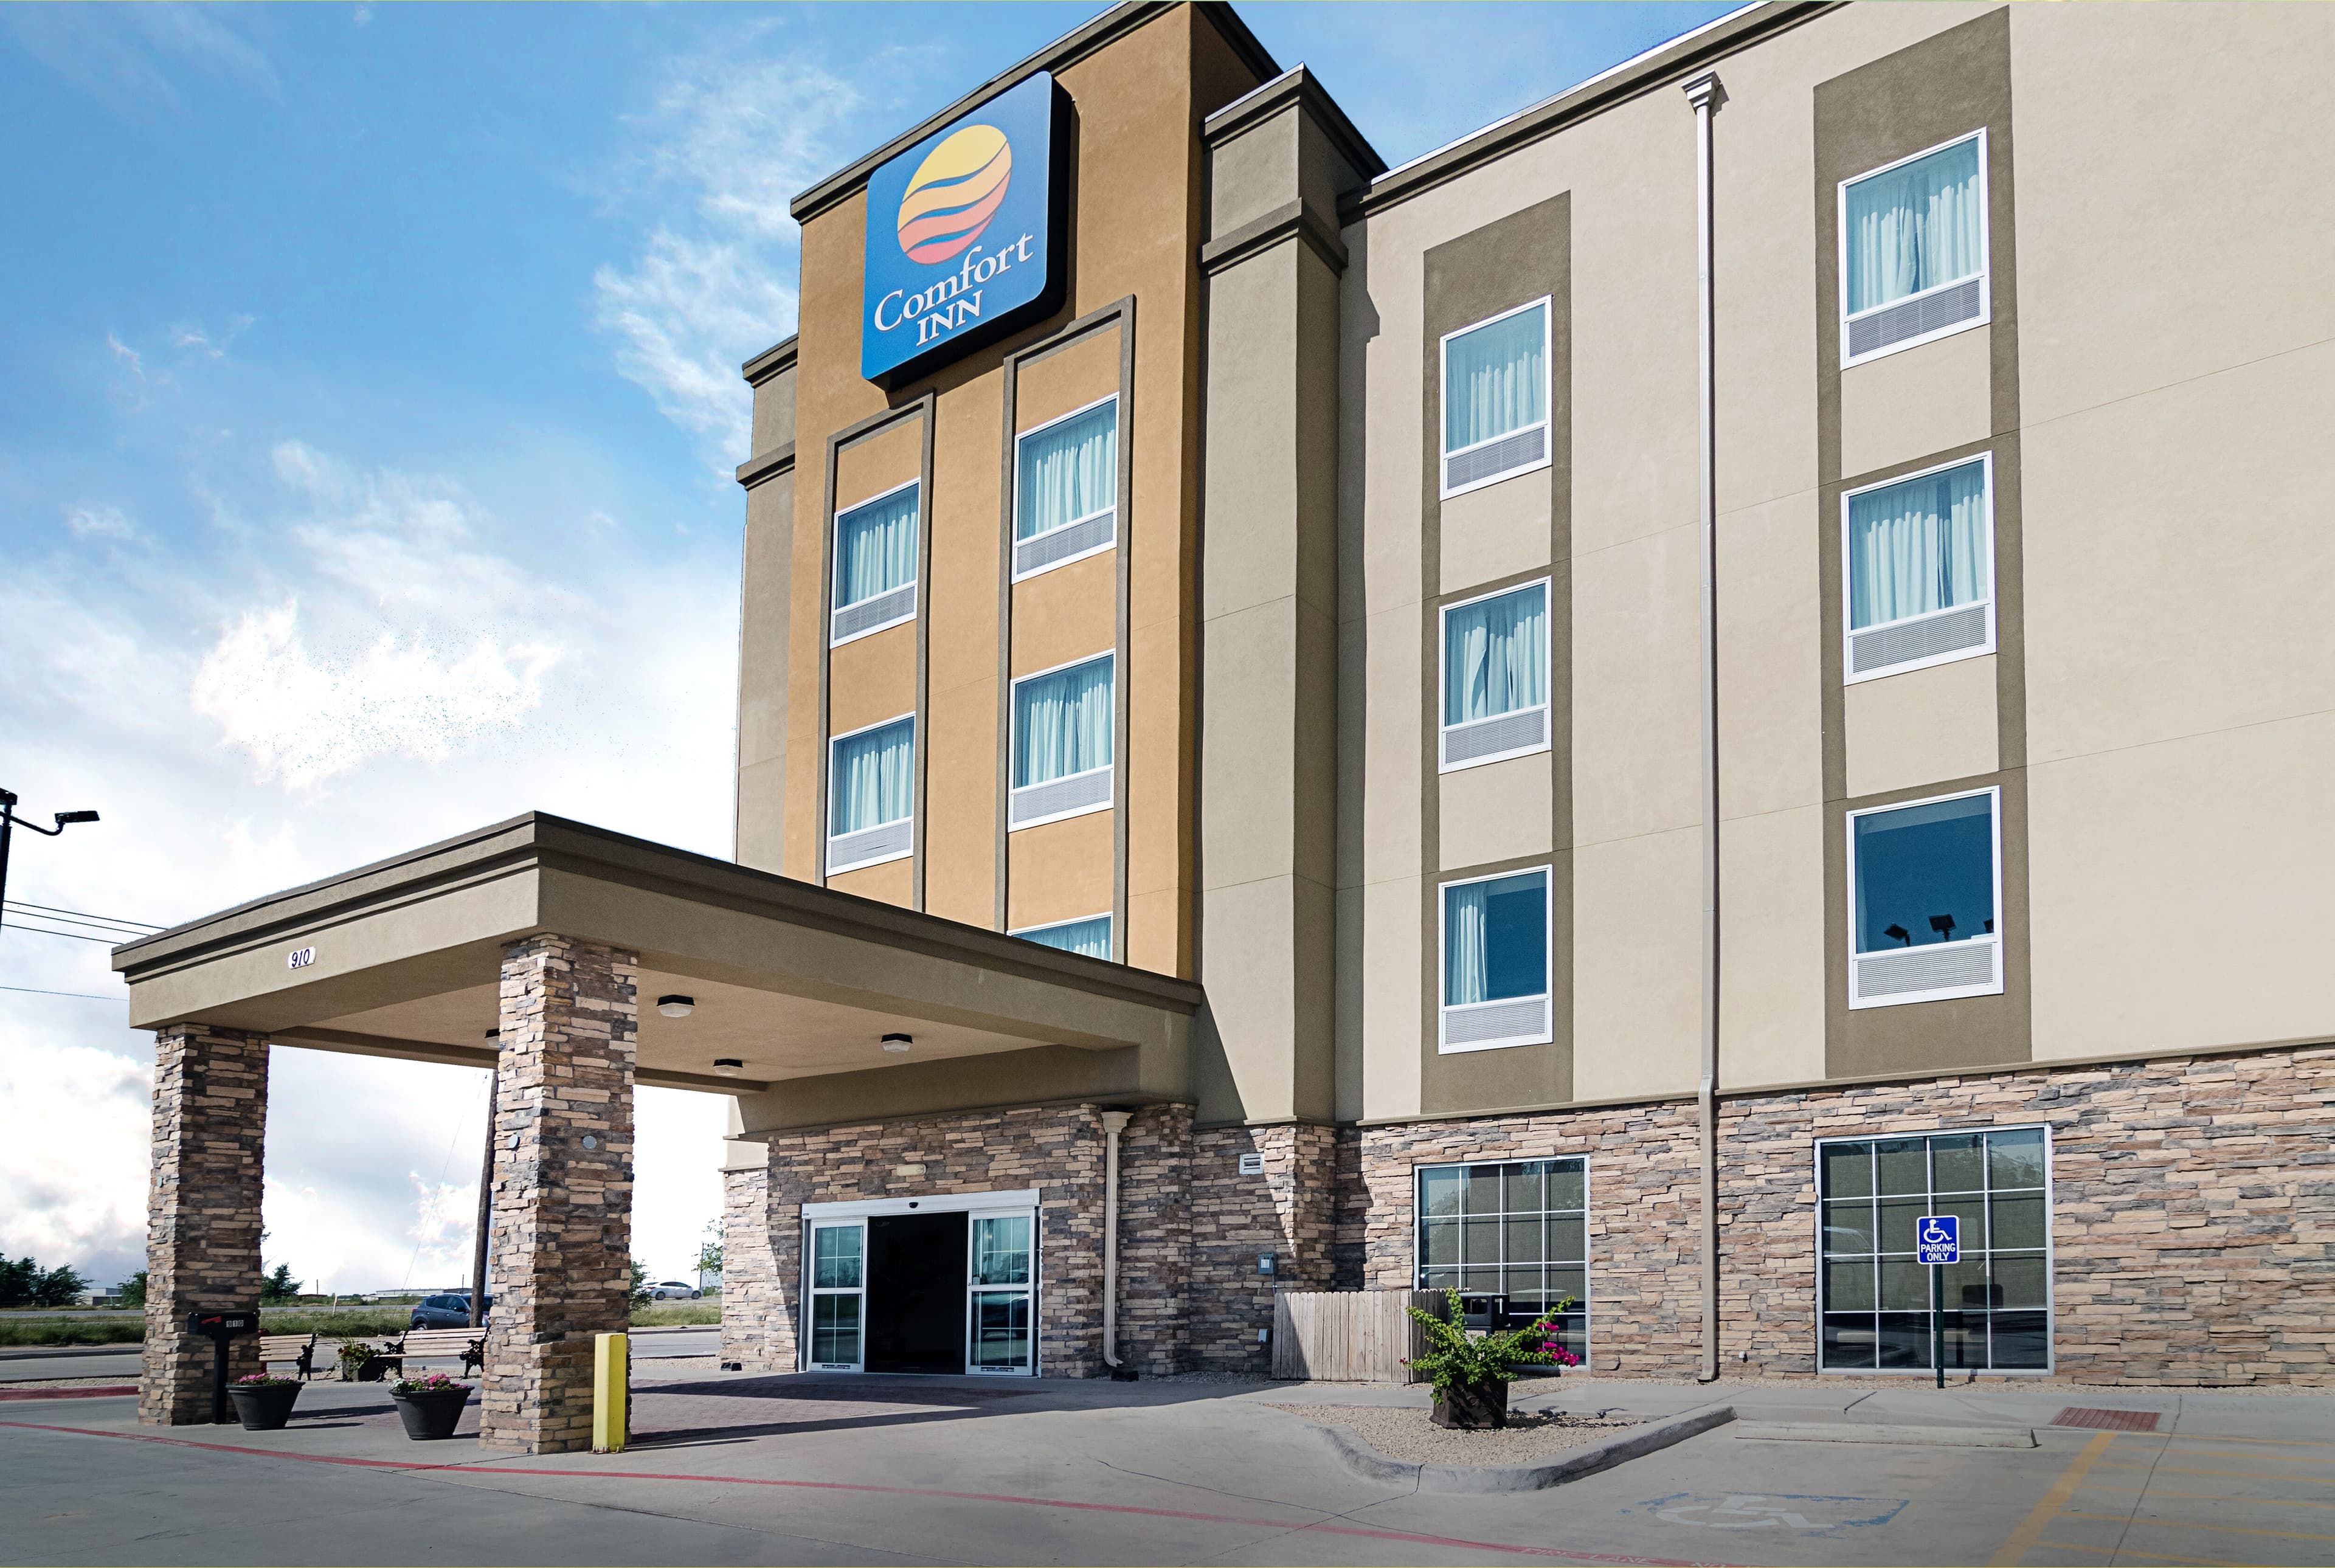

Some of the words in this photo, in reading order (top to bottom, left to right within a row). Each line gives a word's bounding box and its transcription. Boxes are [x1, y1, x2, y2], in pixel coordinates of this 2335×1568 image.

[874, 232, 1034, 332] Comfort
[916, 289, 983, 347] INN
[291, 948, 310, 967] 910
[1920, 1243, 1956, 1253] PARKING
[1926, 1252, 1949, 1262] ONLY
[226, 1319, 244, 1328] 910
[1589, 1554, 1661, 1565] LANE
